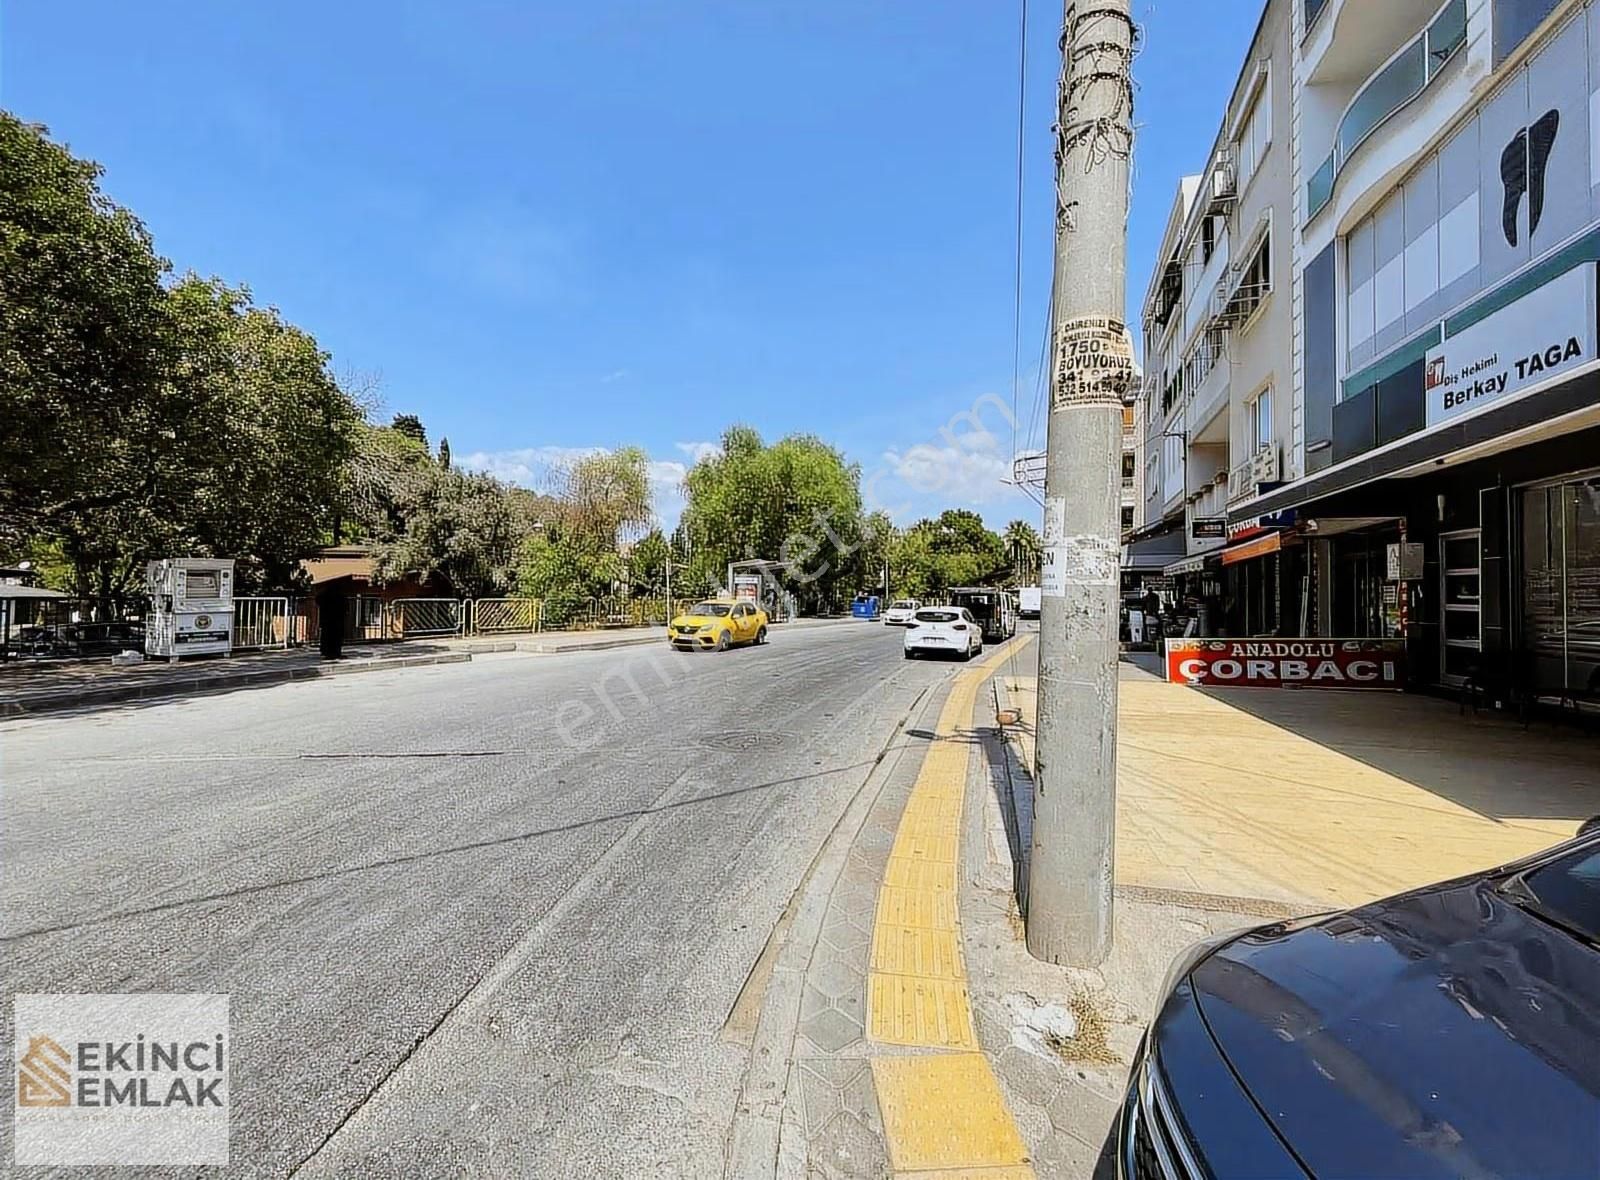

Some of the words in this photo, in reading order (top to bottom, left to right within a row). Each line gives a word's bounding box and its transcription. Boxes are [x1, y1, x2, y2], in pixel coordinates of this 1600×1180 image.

[1443, 371, 1508, 410] Berkay
[1514, 336, 1582, 380] TAGA
[1461, 353, 1498, 379] Hekimi
[1230, 642, 1336, 657] ANADOLU
[1178, 658, 1396, 686] ÇORBACI
